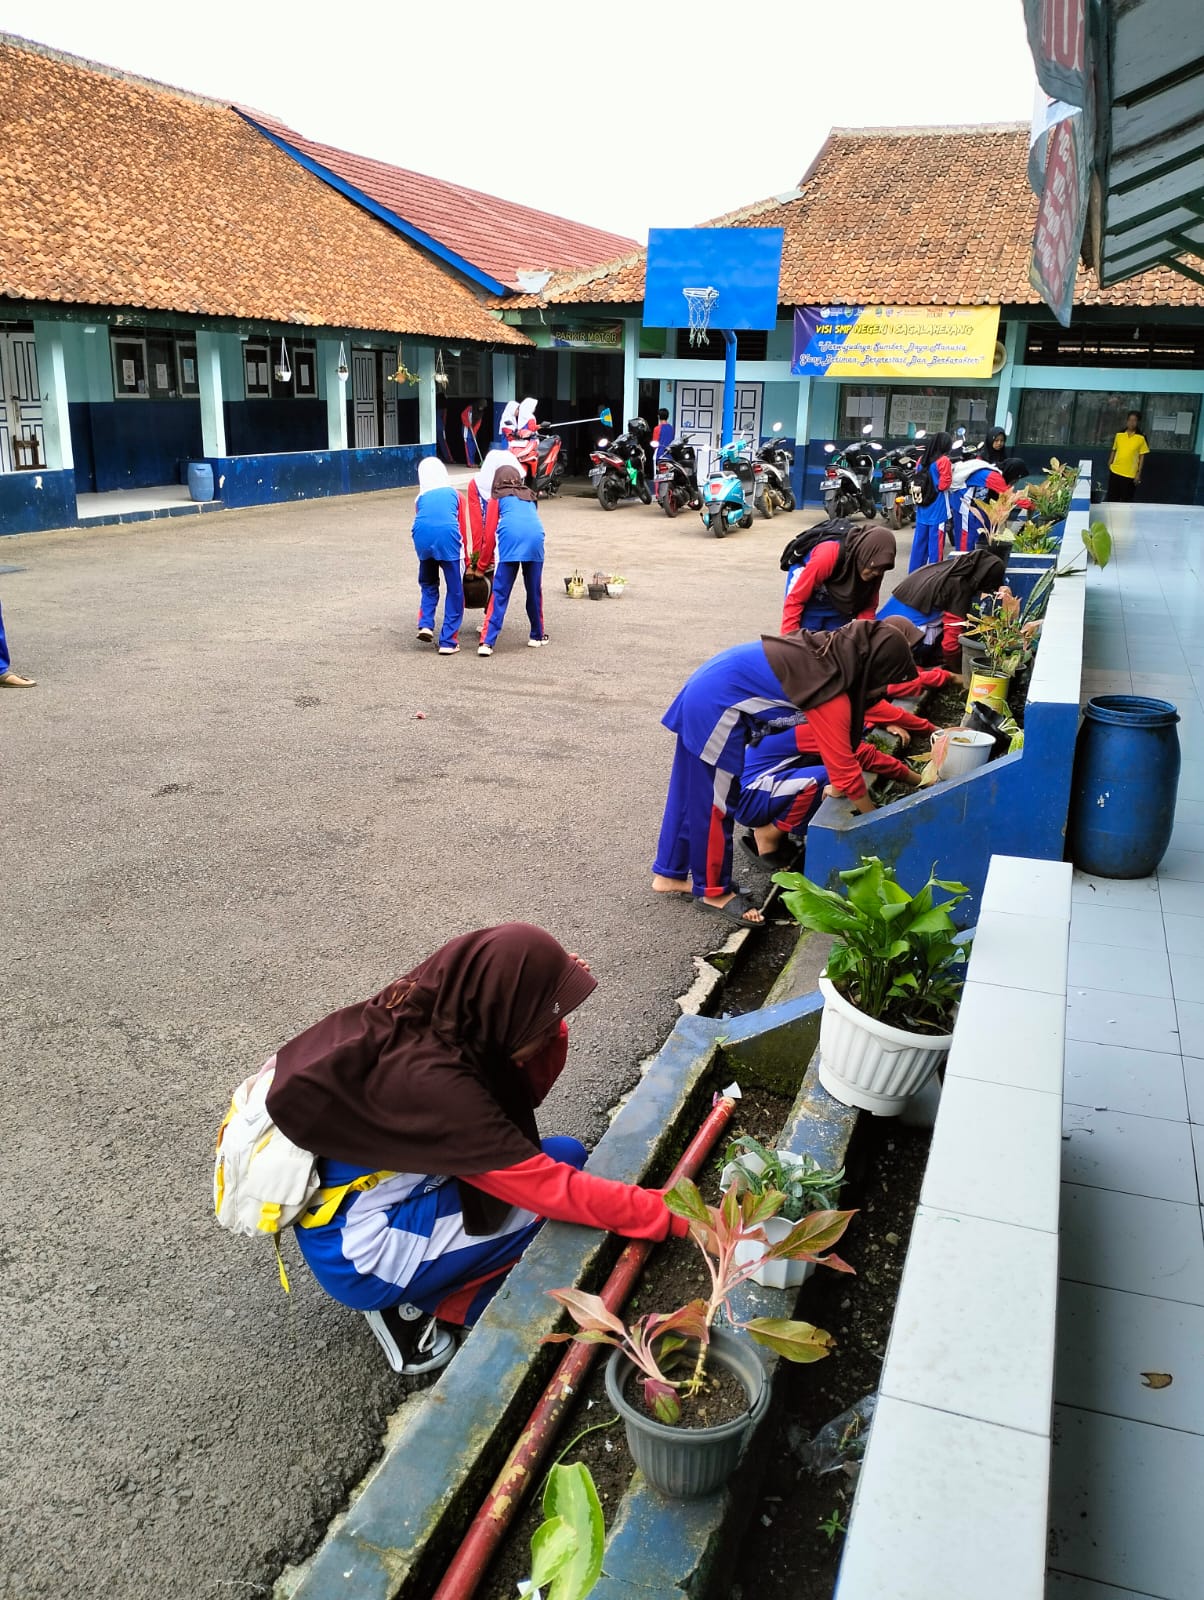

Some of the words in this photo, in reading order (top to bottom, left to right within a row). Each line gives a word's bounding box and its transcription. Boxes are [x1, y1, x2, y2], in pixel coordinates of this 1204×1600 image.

[815, 324, 833, 335] VISI
[834, 324, 852, 335] SMP
[854, 324, 889, 336] NEGERI
[556, 331, 586, 342] PARKIR
[587, 332, 617, 343] MOTOR
[929, 343, 967, 353] Manusia
[799, 353, 823, 367] Yang
